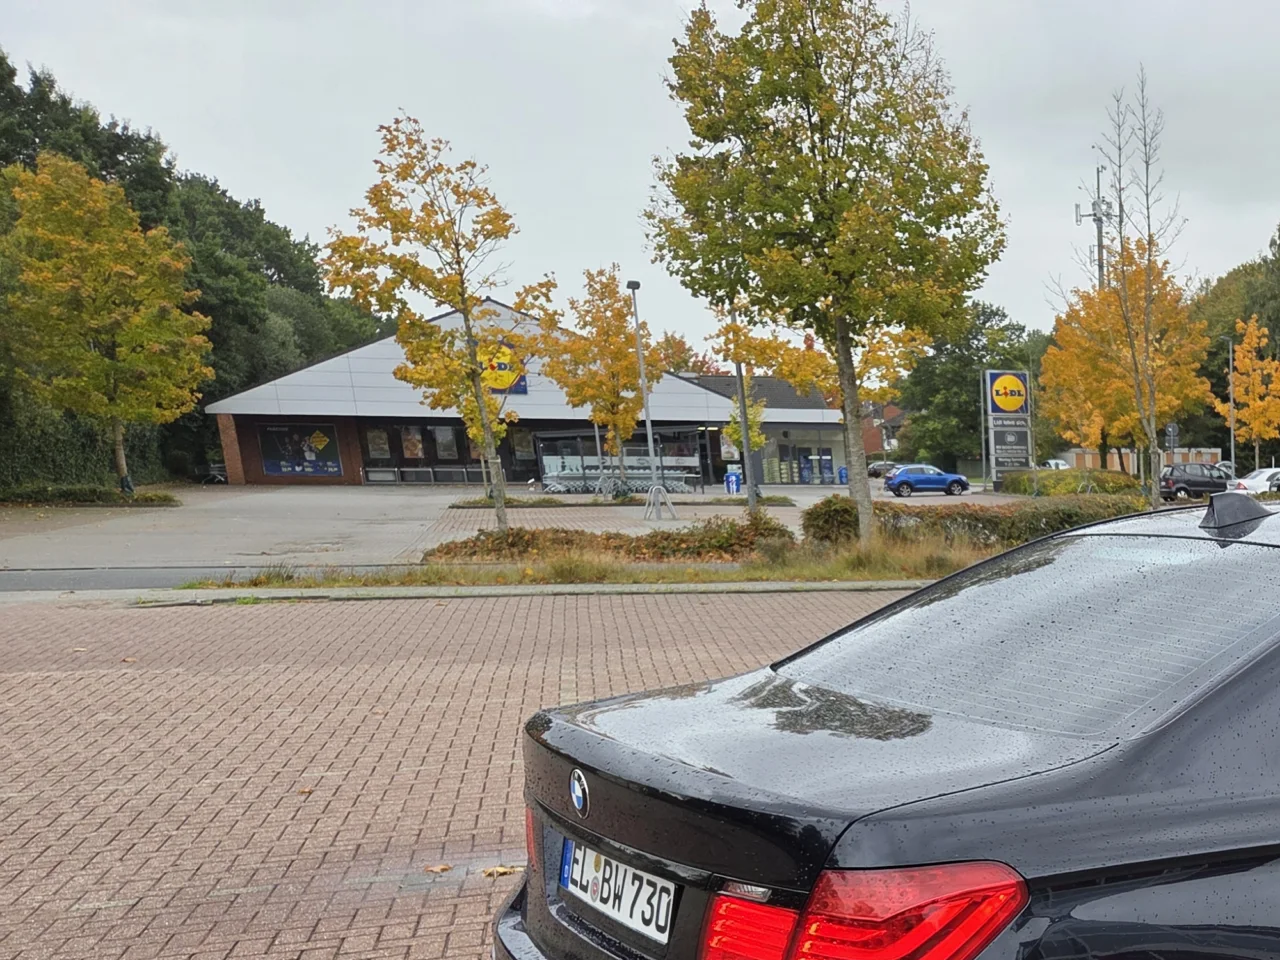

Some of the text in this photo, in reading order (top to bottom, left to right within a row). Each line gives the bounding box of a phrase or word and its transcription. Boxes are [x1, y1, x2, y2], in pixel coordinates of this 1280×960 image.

[570, 842, 671, 935] EL BW 730
